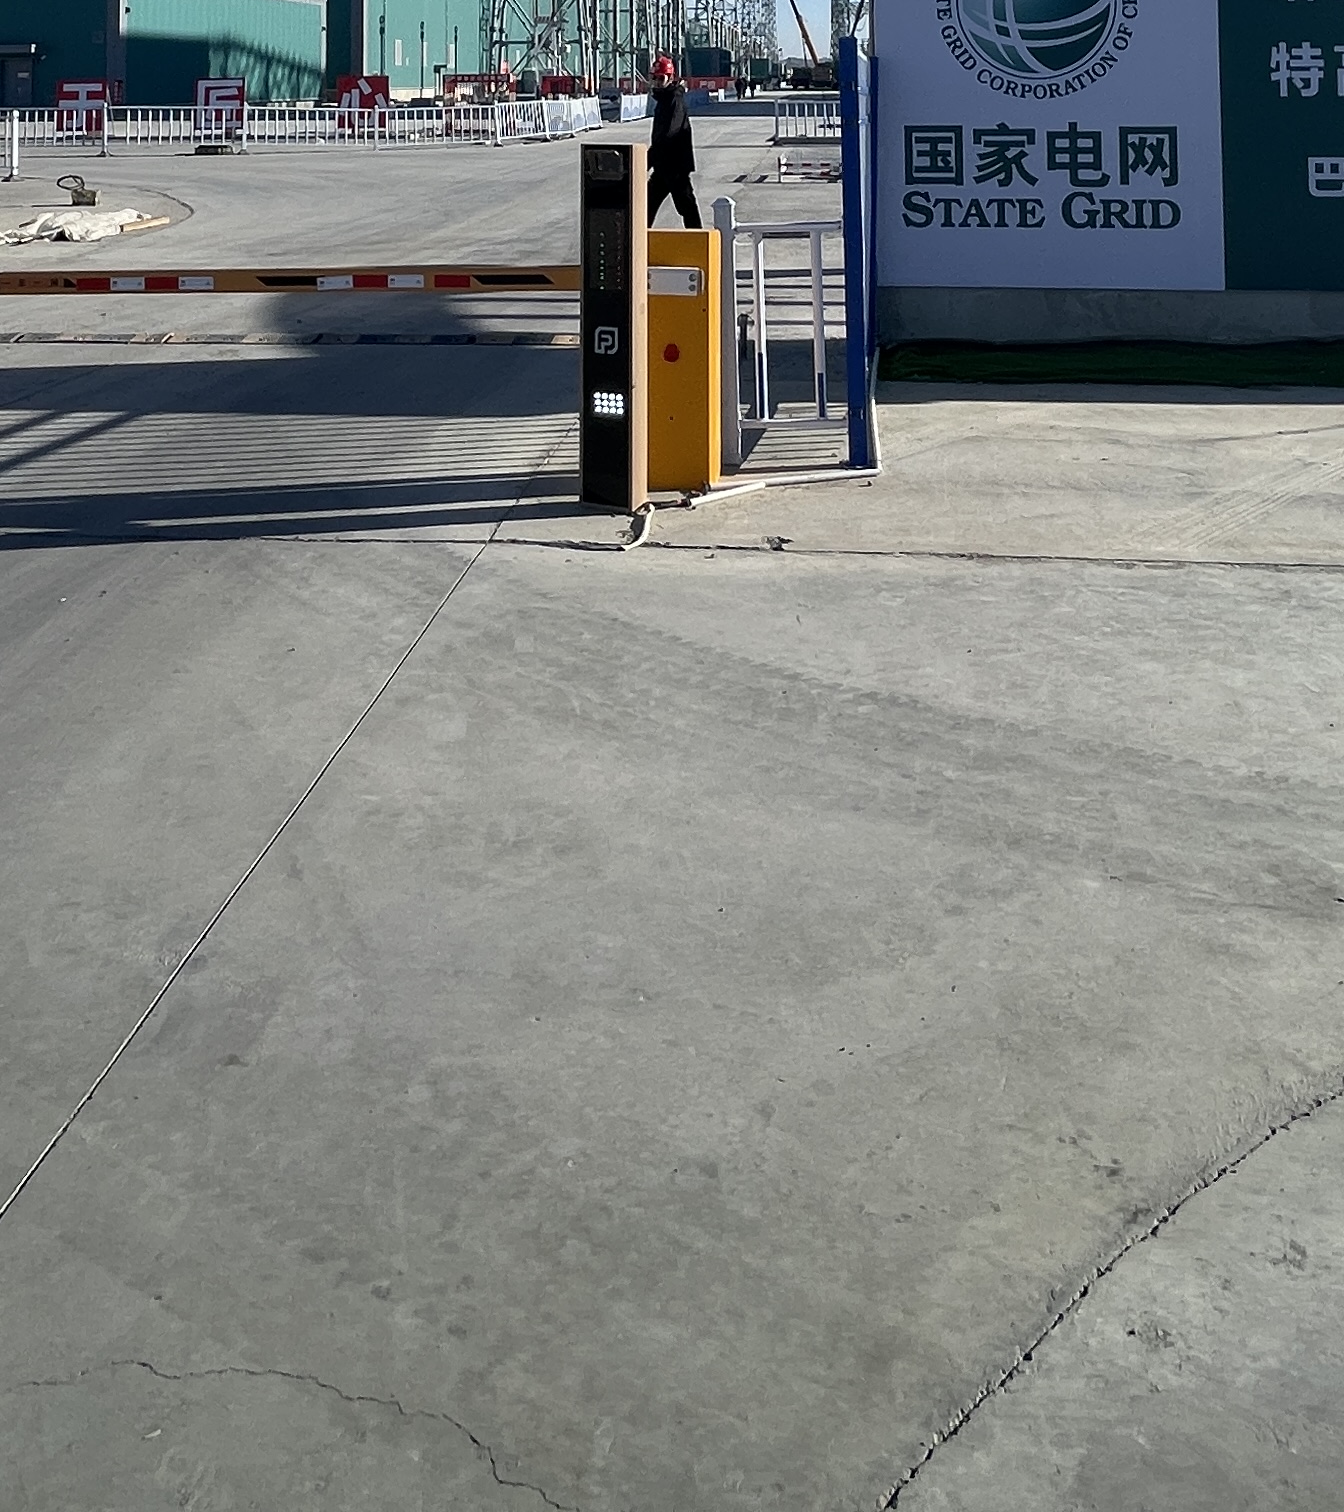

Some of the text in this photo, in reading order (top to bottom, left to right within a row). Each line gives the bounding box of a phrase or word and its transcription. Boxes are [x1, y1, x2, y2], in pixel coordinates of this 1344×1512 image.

[940, 25, 978, 71] GRID
[976, 50, 1119, 100] CORPORATION
[1112, 23, 1134, 52] OF
[903, 121, 1179, 188] 国家电网
[902, 190, 1182, 230] STATE GRID
